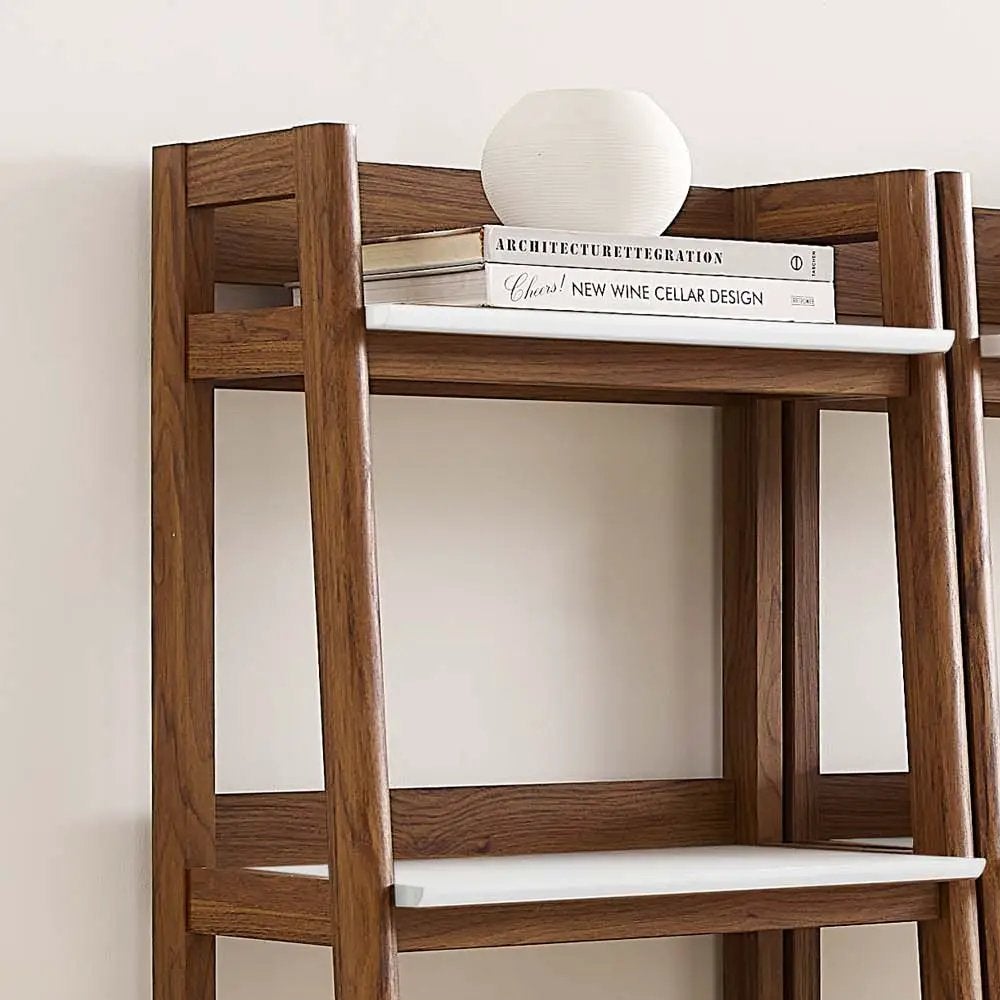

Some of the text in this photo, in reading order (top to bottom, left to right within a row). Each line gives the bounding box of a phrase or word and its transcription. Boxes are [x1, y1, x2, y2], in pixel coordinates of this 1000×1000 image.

[495, 238, 724, 265] ARCHITECTURETTEGRATION
[504, 271, 764, 305] Cheers! NEW WINE CELLAR DESIGN
